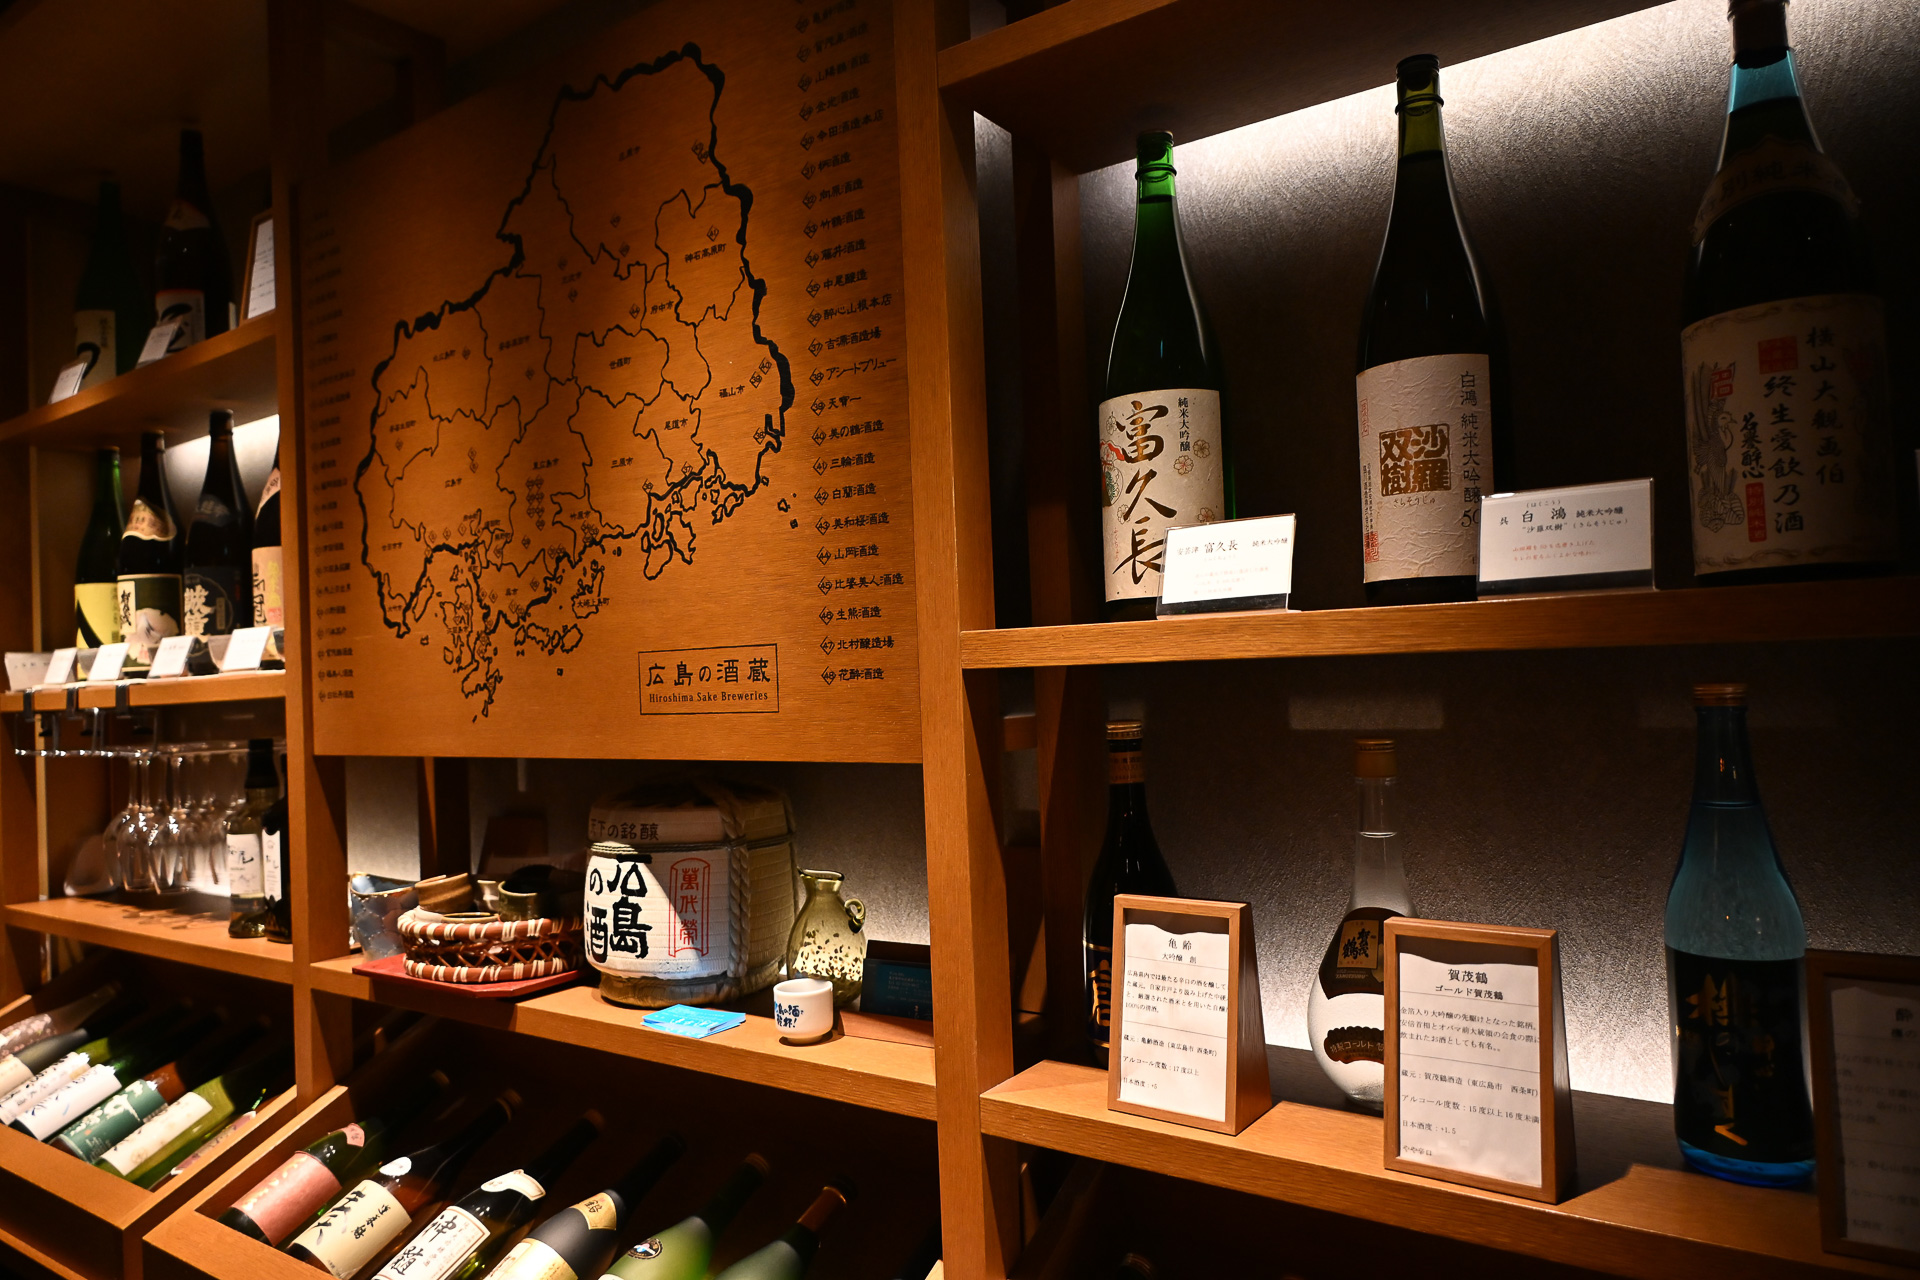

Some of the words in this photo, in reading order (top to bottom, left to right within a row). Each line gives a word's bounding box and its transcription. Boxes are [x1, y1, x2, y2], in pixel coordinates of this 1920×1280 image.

[1807, 326, 1844, 485] 横山大観画伯
[1178, 398, 1190, 452] 純米大吟醸
[830, 452, 876, 469] 三輪酒造
[1461, 413, 1482, 504] 純米大吟醸
[1764, 375, 1804, 534] 終生愛飲乃酒
[1113, 400, 1177, 584] 富久長
[1500, 517, 1508, 526] 呉
[1576, 506, 1624, 518] 純米大吟醸
[1204, 540, 1238, 554] 富久長
[646, 658, 770, 686] 広島の酒蔵
[649, 693, 694, 703] Hiroshima
[696, 692, 718, 702] Sake
[722, 690, 768, 701] Breweries
[1162, 952, 1183, 962] 大吟醸
[1448, 968, 1488, 985] 賀茂鶴
[1436, 984, 1504, 1001] ゴールド賀茂鶴
